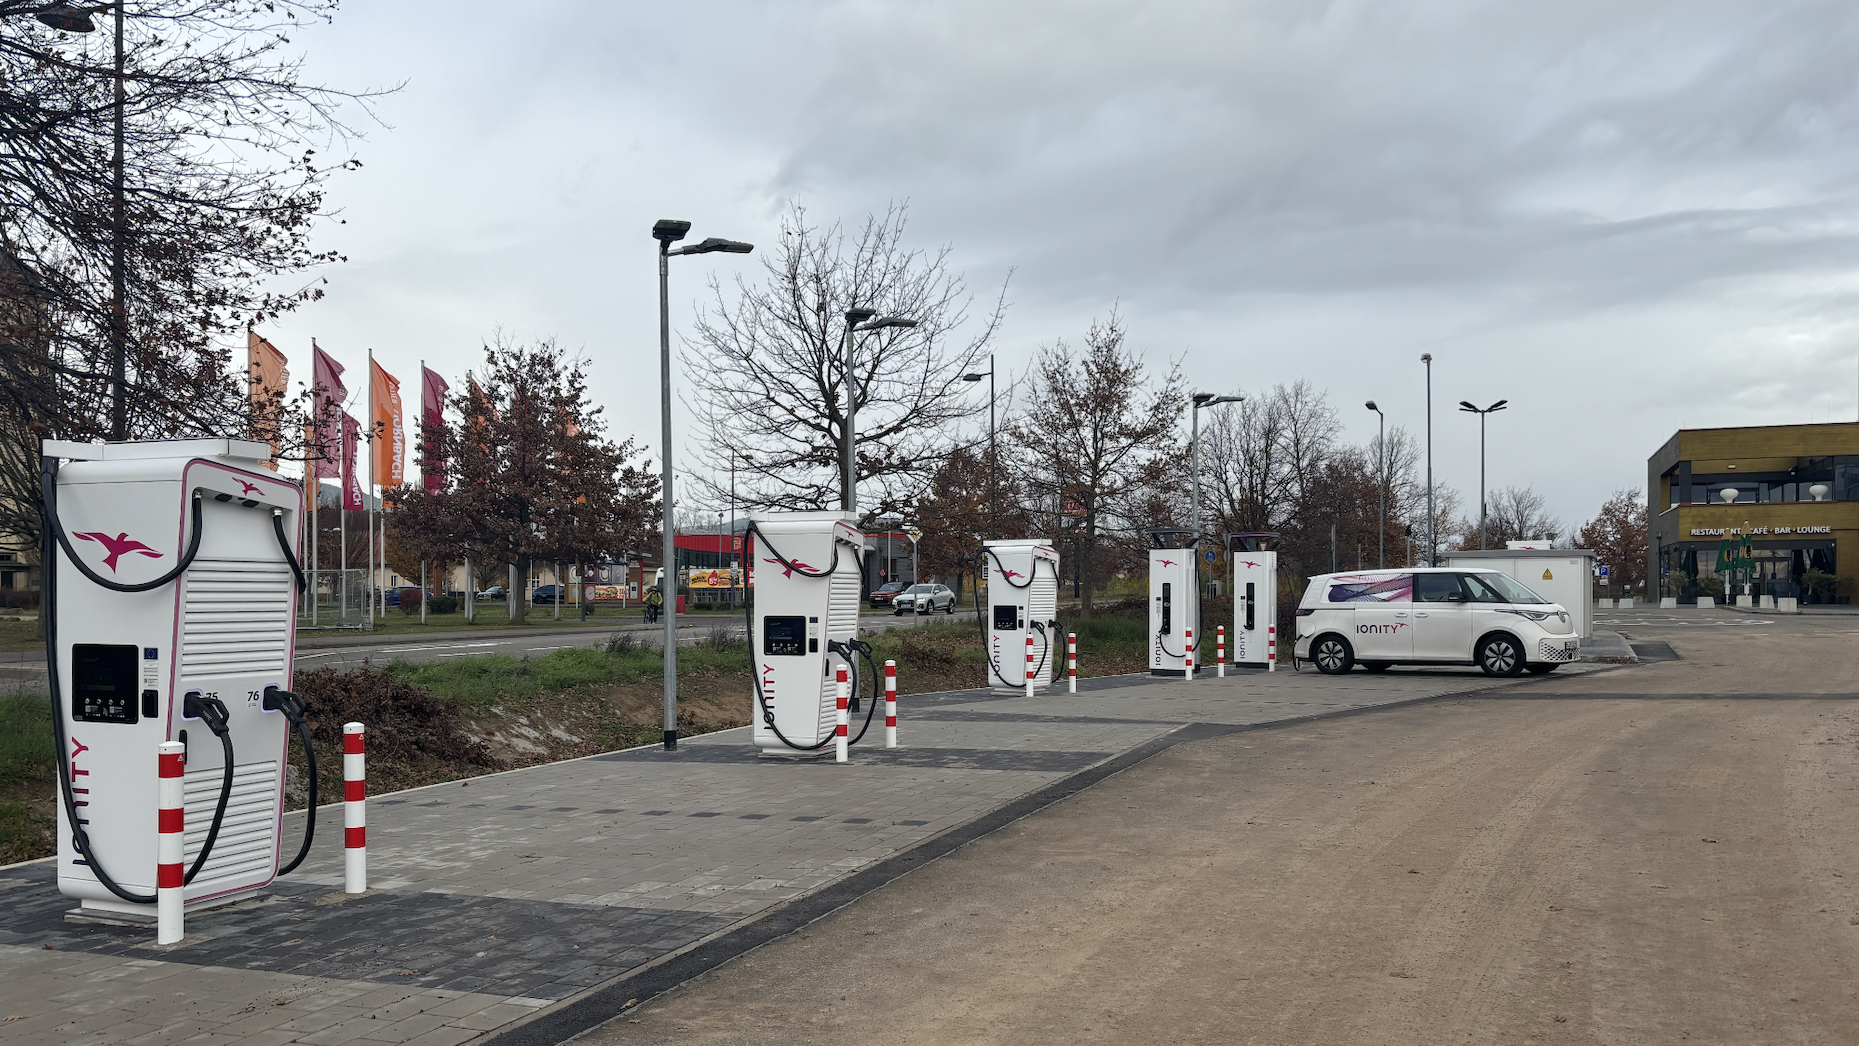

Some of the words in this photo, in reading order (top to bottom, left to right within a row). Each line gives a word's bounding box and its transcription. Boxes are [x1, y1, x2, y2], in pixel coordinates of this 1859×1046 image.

[1691, 527, 1741, 536] RESTAURNT
[1796, 526, 1831, 534] LOUNGE
[1356, 624, 1398, 634] IONITY
[247, 691, 259, 701] 76
